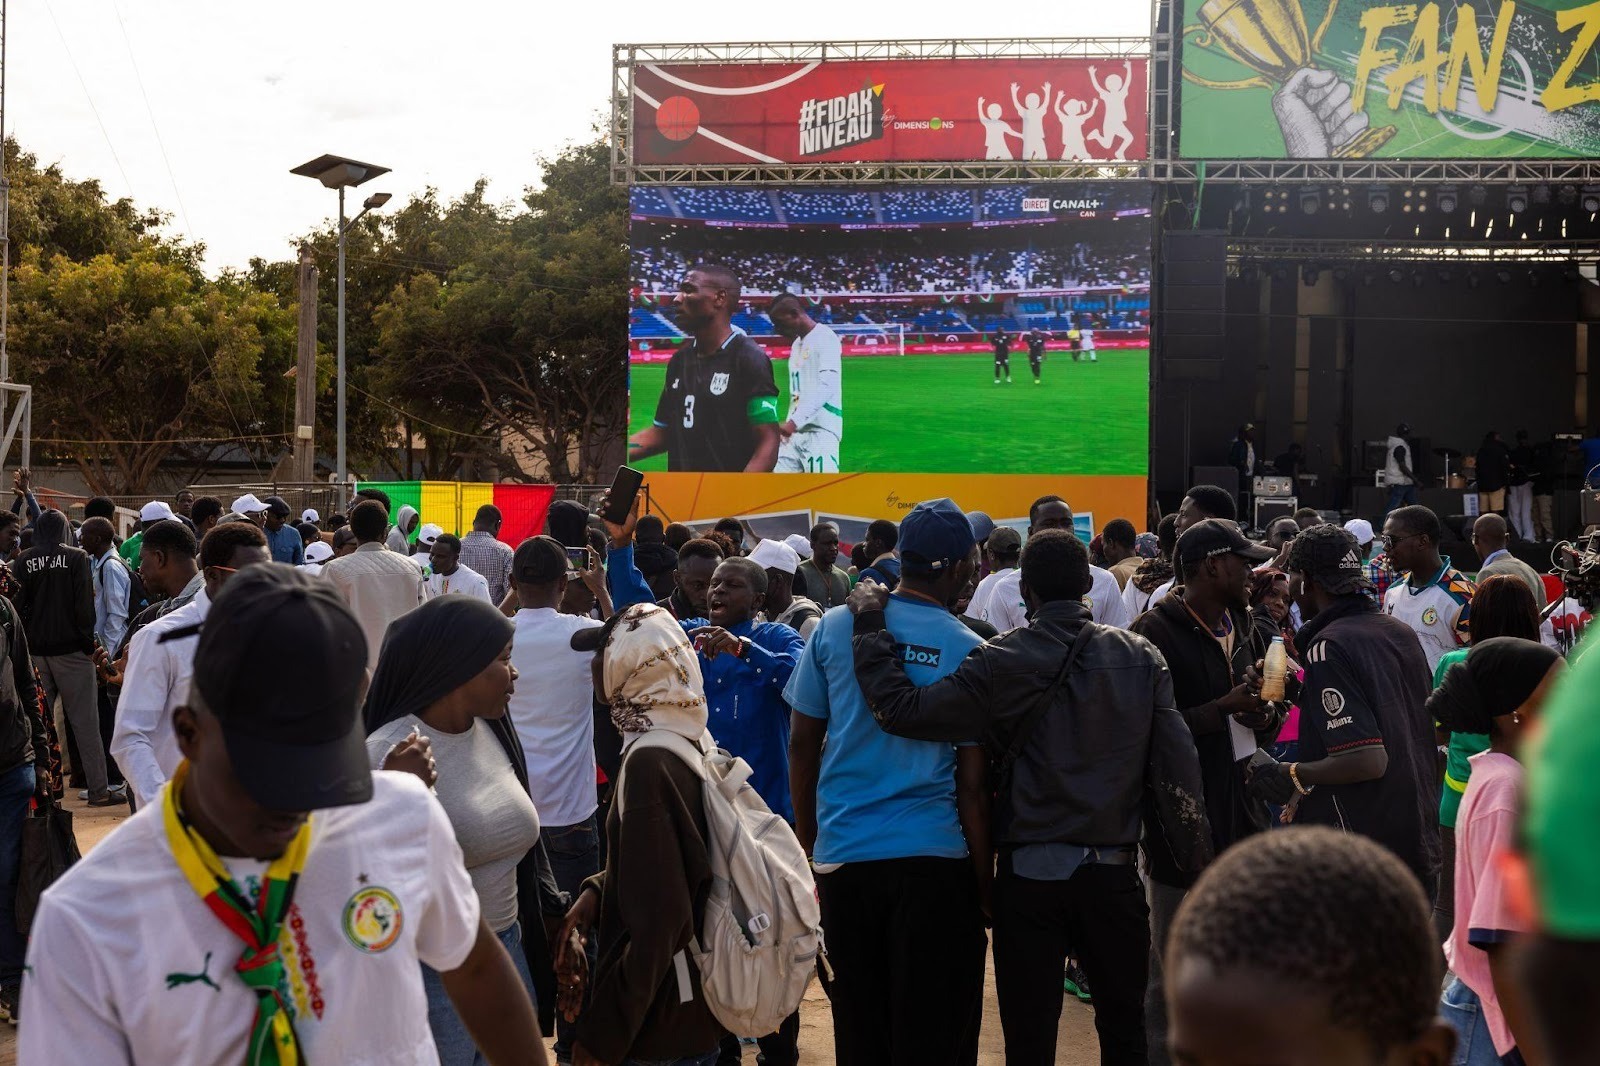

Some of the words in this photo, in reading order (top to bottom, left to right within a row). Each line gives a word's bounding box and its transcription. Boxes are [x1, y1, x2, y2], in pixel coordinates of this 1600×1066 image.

[1351, 1, 1516, 114] FAN
[799, 88, 872, 131] #FIDAK
[799, 112, 872, 155] NIVEAU
[1024, 200, 1048, 209] DIRECT
[1053, 199, 1099, 209] CANAL+
[683, 394, 695, 429] 3
[808, 455, 823, 473] 11
[1339, 560, 1360, 569] adidas
[1327, 716, 1353, 730] Allianz
